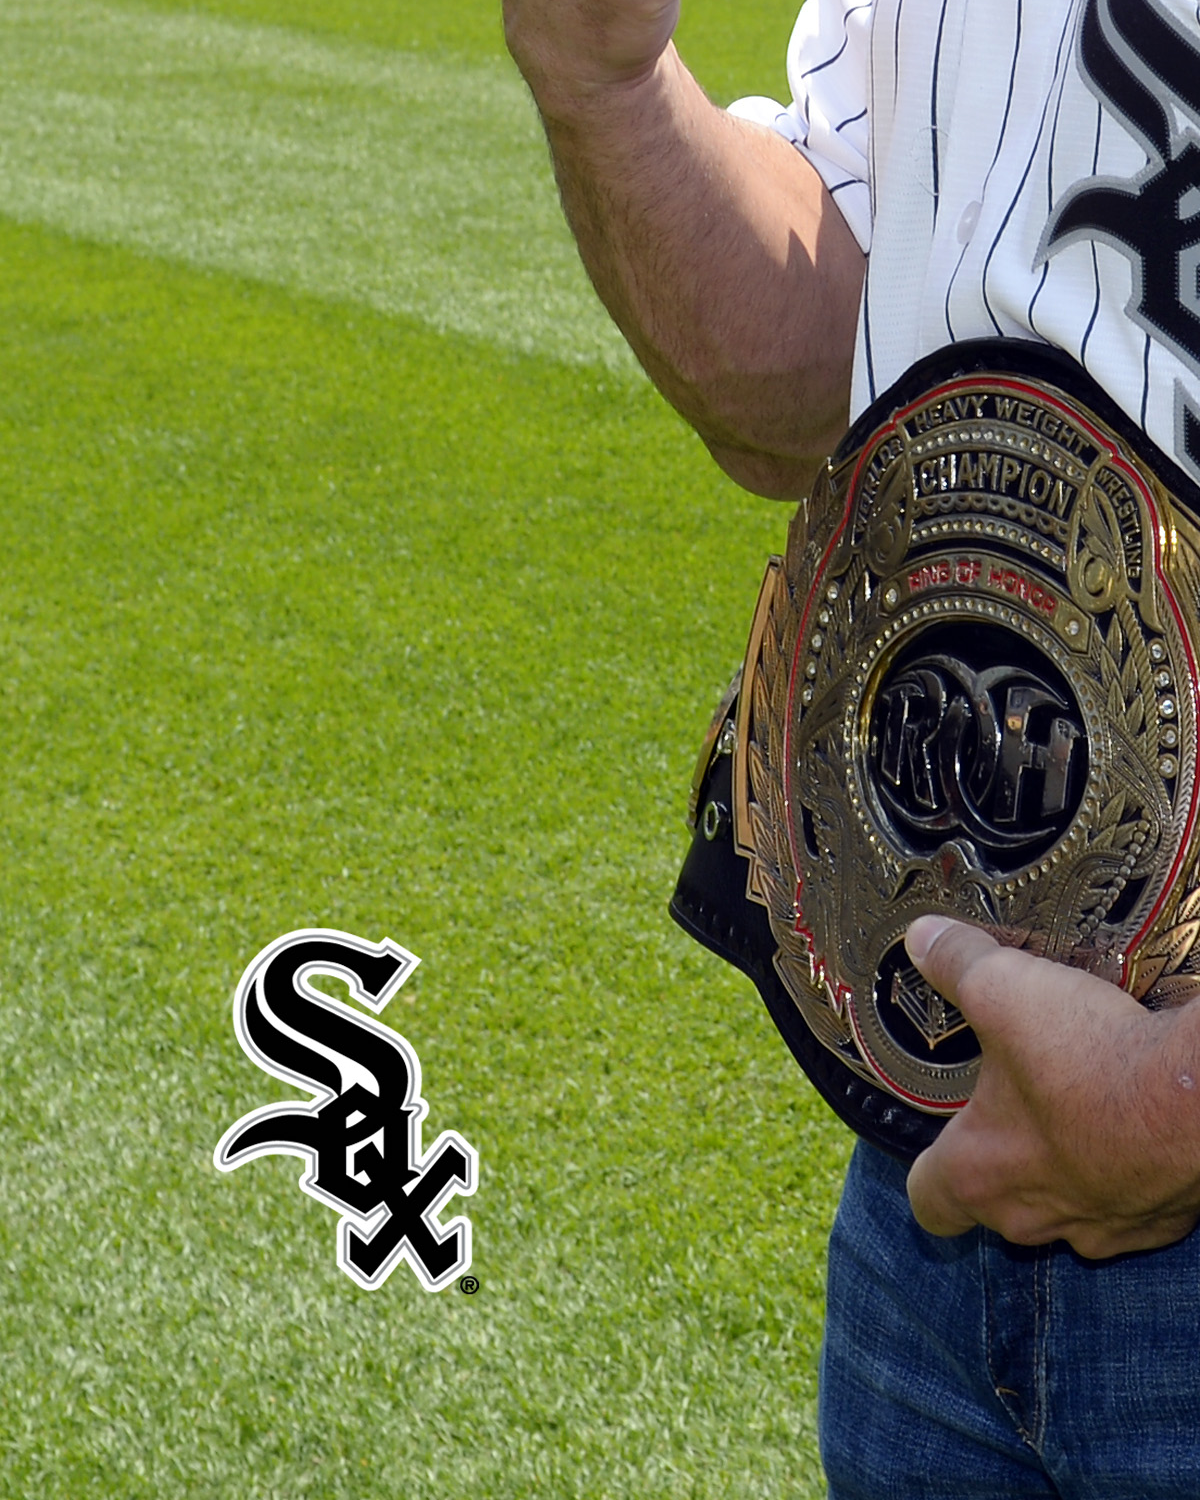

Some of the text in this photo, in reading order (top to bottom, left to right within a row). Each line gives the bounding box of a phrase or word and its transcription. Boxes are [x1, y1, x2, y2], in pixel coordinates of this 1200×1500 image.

[914, 394, 988, 434] HEAVY
[994, 396, 1090, 455] WEIGHT
[919, 452, 1073, 520] CHAMPION
[907, 558, 1057, 615] RING OF HONOR
